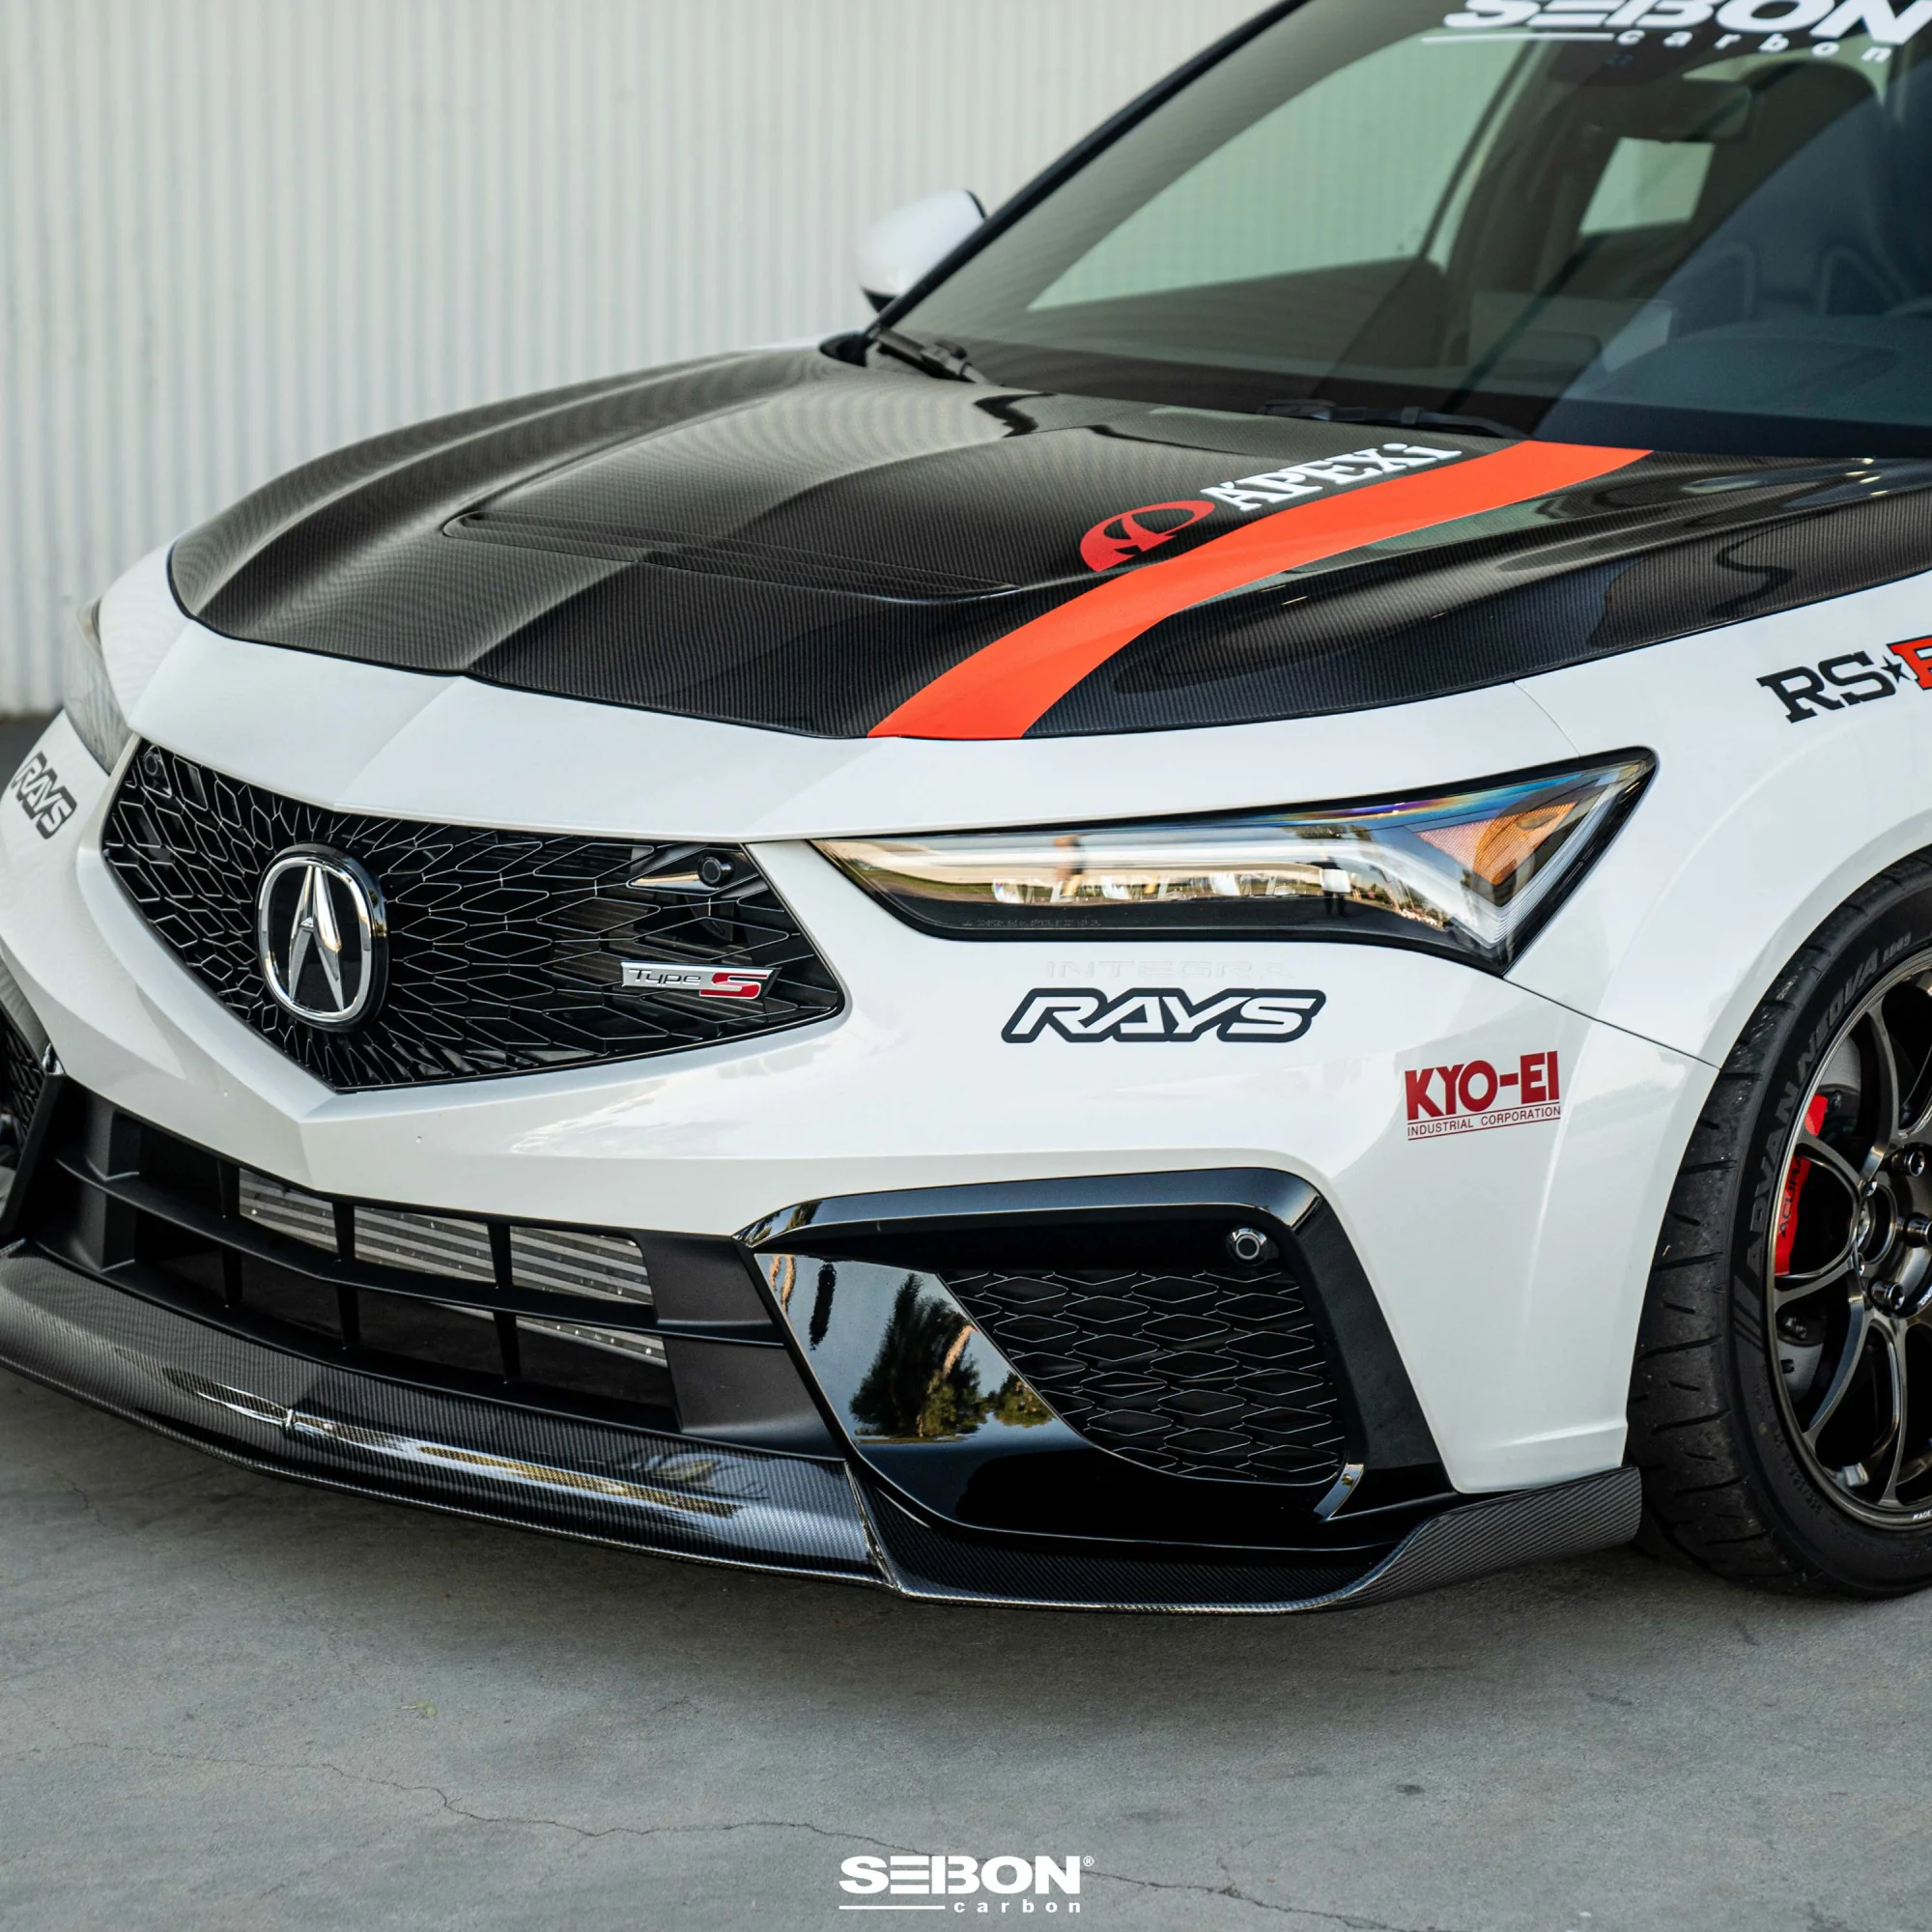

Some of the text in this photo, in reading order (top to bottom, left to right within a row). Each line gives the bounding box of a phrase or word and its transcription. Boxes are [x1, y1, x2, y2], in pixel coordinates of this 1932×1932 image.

[1617, 29, 1893, 63] carbon
[11, 751, 77, 839] RAYS
[628, 968, 701, 987] Type
[1045, 959, 1296, 980] INTEGRA
[1001, 987, 1327, 1043] RAYS
[1405, 1051, 1560, 1121] KYO-EI
[1407, 1105, 1561, 1137] INDUSTRIAL CORPORATION
